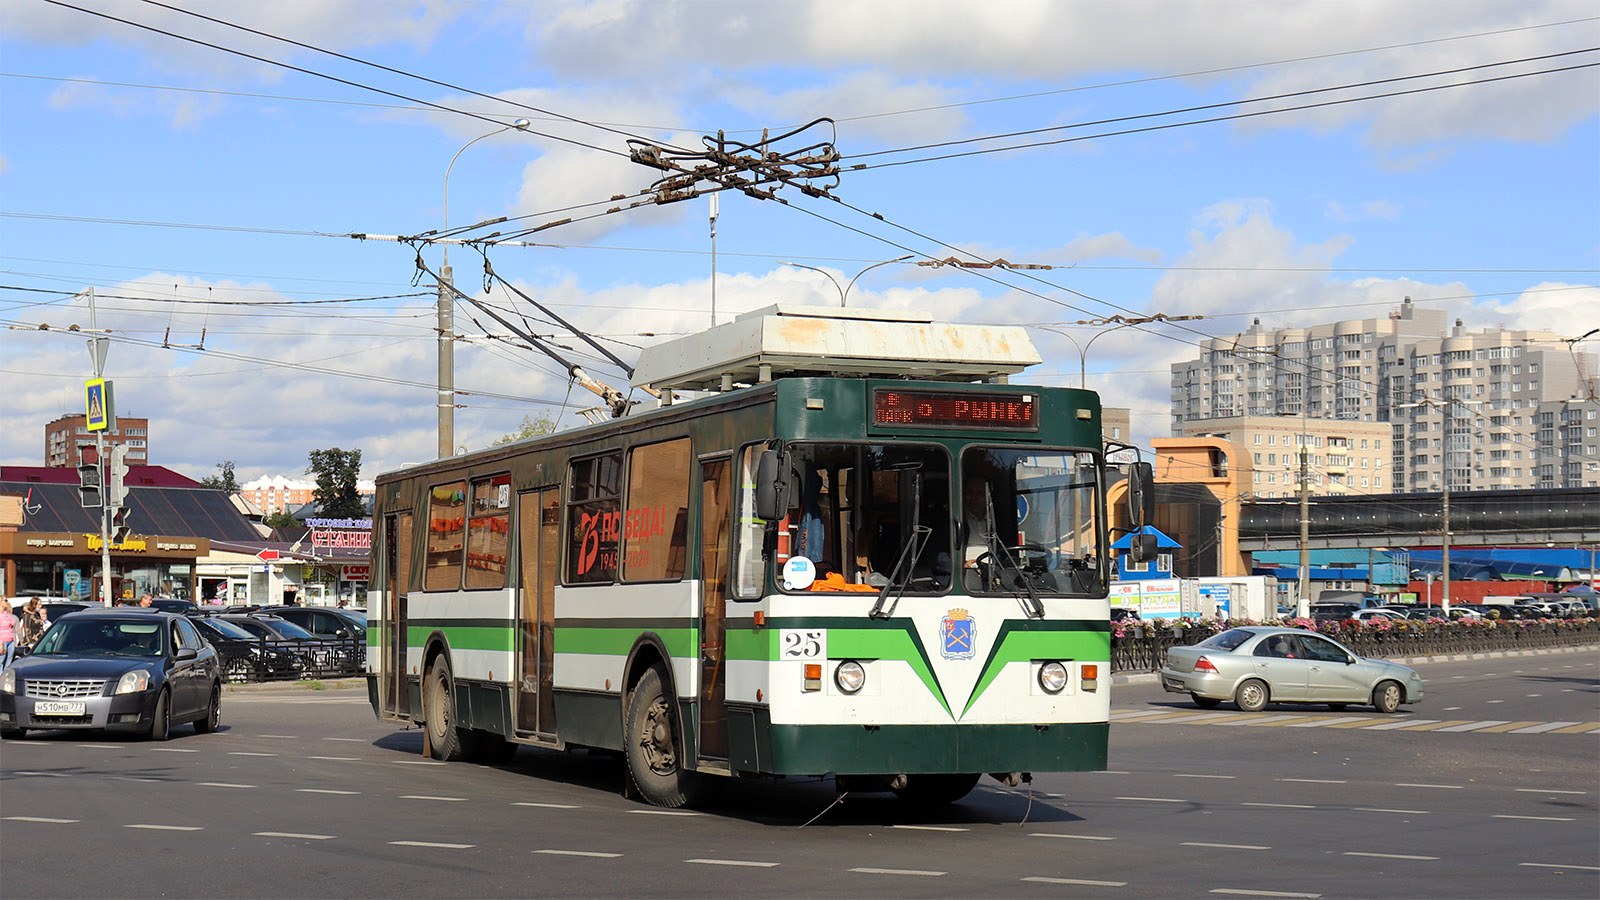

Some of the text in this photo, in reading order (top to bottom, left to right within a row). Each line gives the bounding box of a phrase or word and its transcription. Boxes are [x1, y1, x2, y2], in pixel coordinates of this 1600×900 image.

[888, 393, 899, 406] В
[877, 409, 913, 423] ПАРК
[500, 486, 509, 504] 25
[305, 517, 353, 529] ТОРГОВЫЙ
[602, 505, 666, 544] ПОБЕДА!
[785, 632, 821, 657] 25
